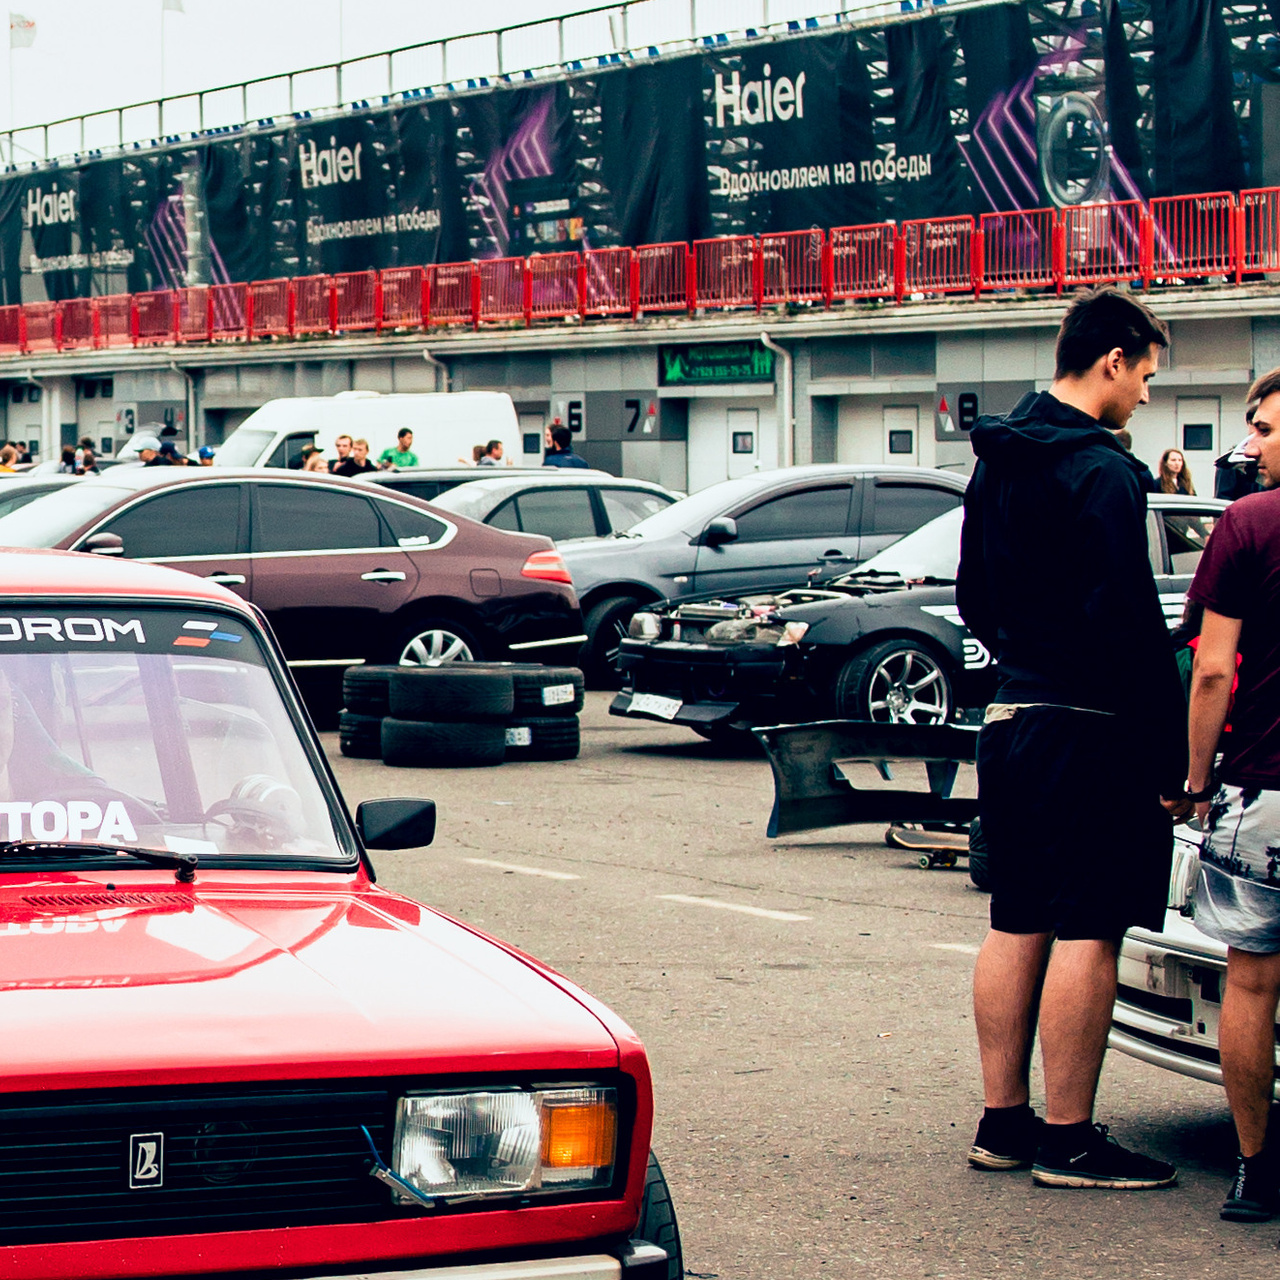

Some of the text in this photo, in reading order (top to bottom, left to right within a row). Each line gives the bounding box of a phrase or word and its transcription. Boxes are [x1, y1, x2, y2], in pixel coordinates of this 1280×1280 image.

[714, 63, 806, 128] Haier
[298, 135, 362, 189] Haier
[719, 150, 932, 197] Вдохновляем на победы
[27, 182, 76, 228] Haier
[125, 409, 134, 434] 3
[568, 401, 582, 432] 6
[625, 400, 641, 432] 7
[958, 392, 979, 431] 8
